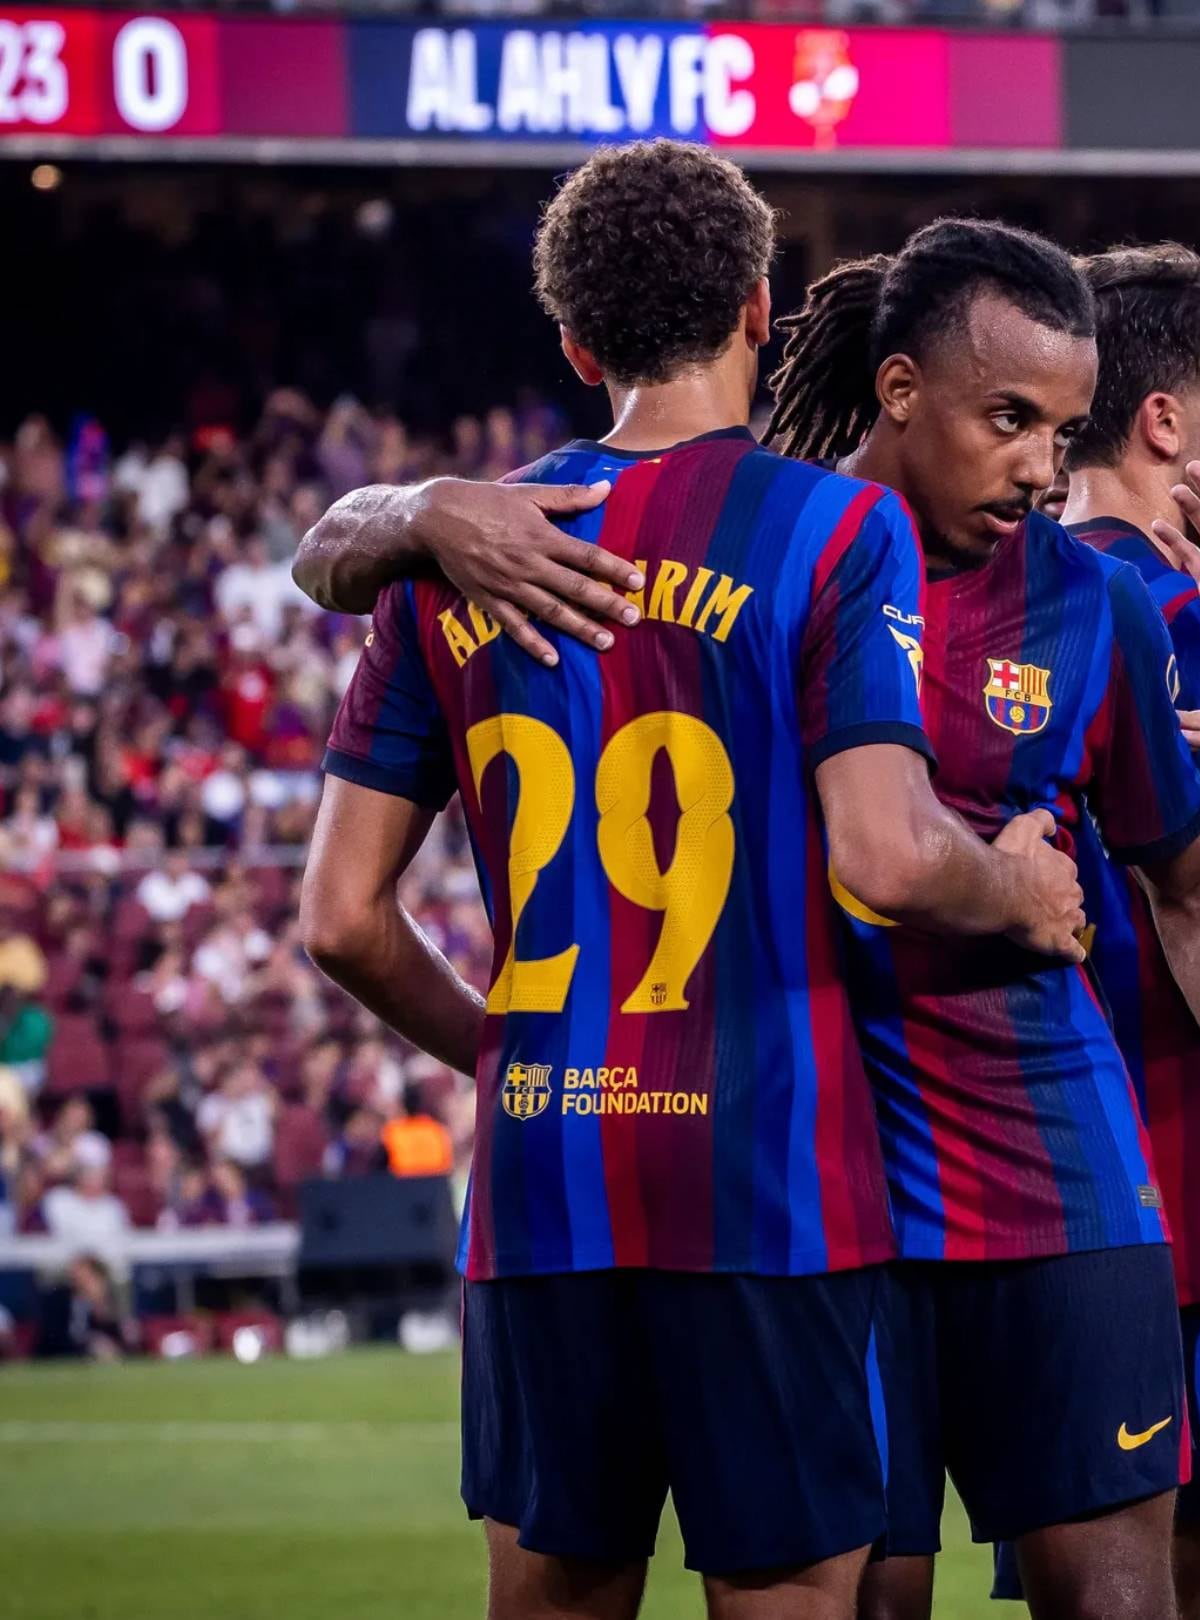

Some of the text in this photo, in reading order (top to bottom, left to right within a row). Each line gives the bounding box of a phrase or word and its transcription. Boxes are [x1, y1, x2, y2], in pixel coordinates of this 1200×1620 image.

[112, 15, 188, 132] 0
[406, 28, 756, 136] AL AHLY FC
[465, 711, 736, 1015] 29
[561, 1092, 708, 1116] FOUNDATION
[563, 1066, 639, 1092] BARÇA
